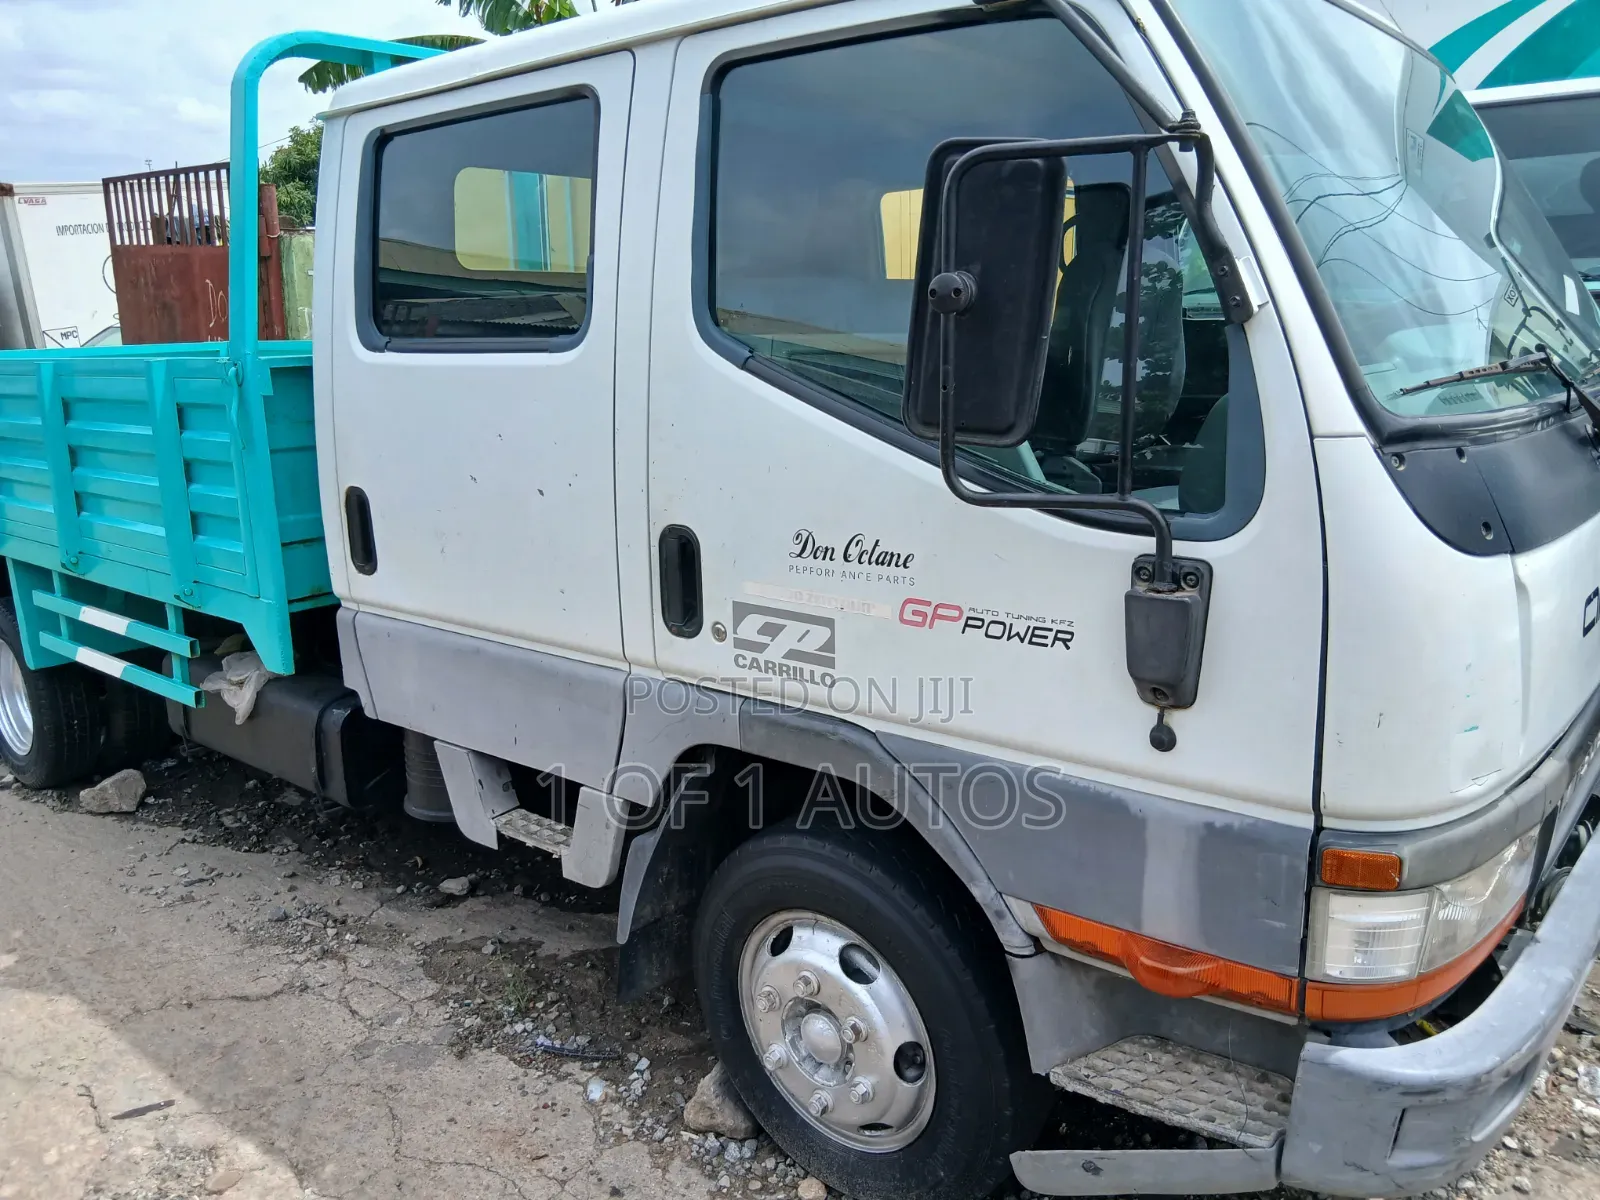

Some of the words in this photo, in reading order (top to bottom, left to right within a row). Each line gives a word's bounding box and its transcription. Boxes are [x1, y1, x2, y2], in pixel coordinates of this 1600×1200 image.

[55, 223, 104, 236] IMPORTACION
[60, 330, 78, 341] MPC
[788, 528, 836, 562] Don
[842, 532, 915, 569] Octane
[877, 573, 916, 587] PARTS
[899, 597, 964, 630] GP
[968, 606, 999, 617] AUTO
[1005, 611, 1047, 624] TUNING
[1051, 618, 1075, 628] KFZ
[961, 615, 1075, 651] POWER
[733, 653, 836, 689] CARRILLO
